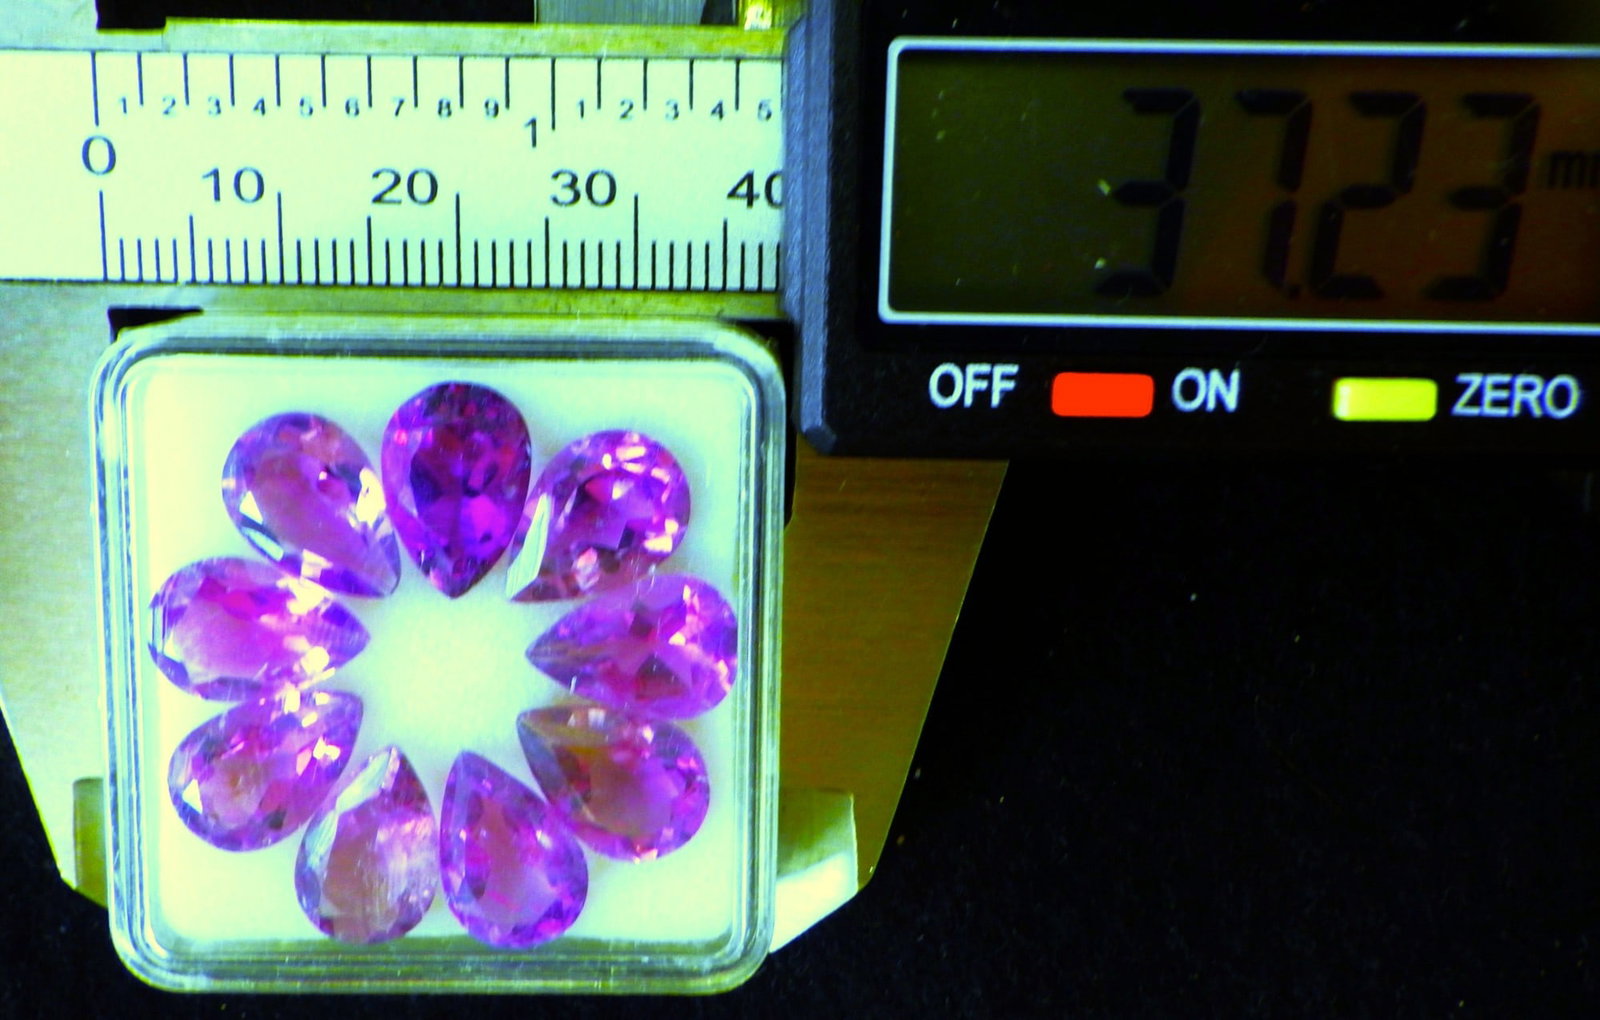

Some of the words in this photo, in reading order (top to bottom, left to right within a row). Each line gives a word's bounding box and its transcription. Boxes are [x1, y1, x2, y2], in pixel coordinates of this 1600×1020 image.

[119, 97, 127, 114] 1
[162, 96, 176, 116] 2
[208, 96, 222, 116] 3
[253, 97, 266, 116] 4
[300, 98, 313, 117] 5
[345, 98, 359, 117] 6
[392, 98, 404, 117] 7
[438, 99, 452, 118] 8
[484, 98, 499, 118] 9
[577, 99, 584, 119] 1
[619, 100, 633, 119] 2
[666, 101, 679, 120] 3
[711, 101, 724, 121] 4
[758, 101, 772, 121] 5
[524, 117, 537, 148] 1
[82, 135, 117, 175] 0
[202, 167, 265, 203] 10
[371, 167, 438, 205] 20
[550, 169, 617, 207] 30
[928, 363, 1019, 408] OFF
[1171, 368, 1240, 413] ON
[1452, 374, 1579, 419] ZERO
